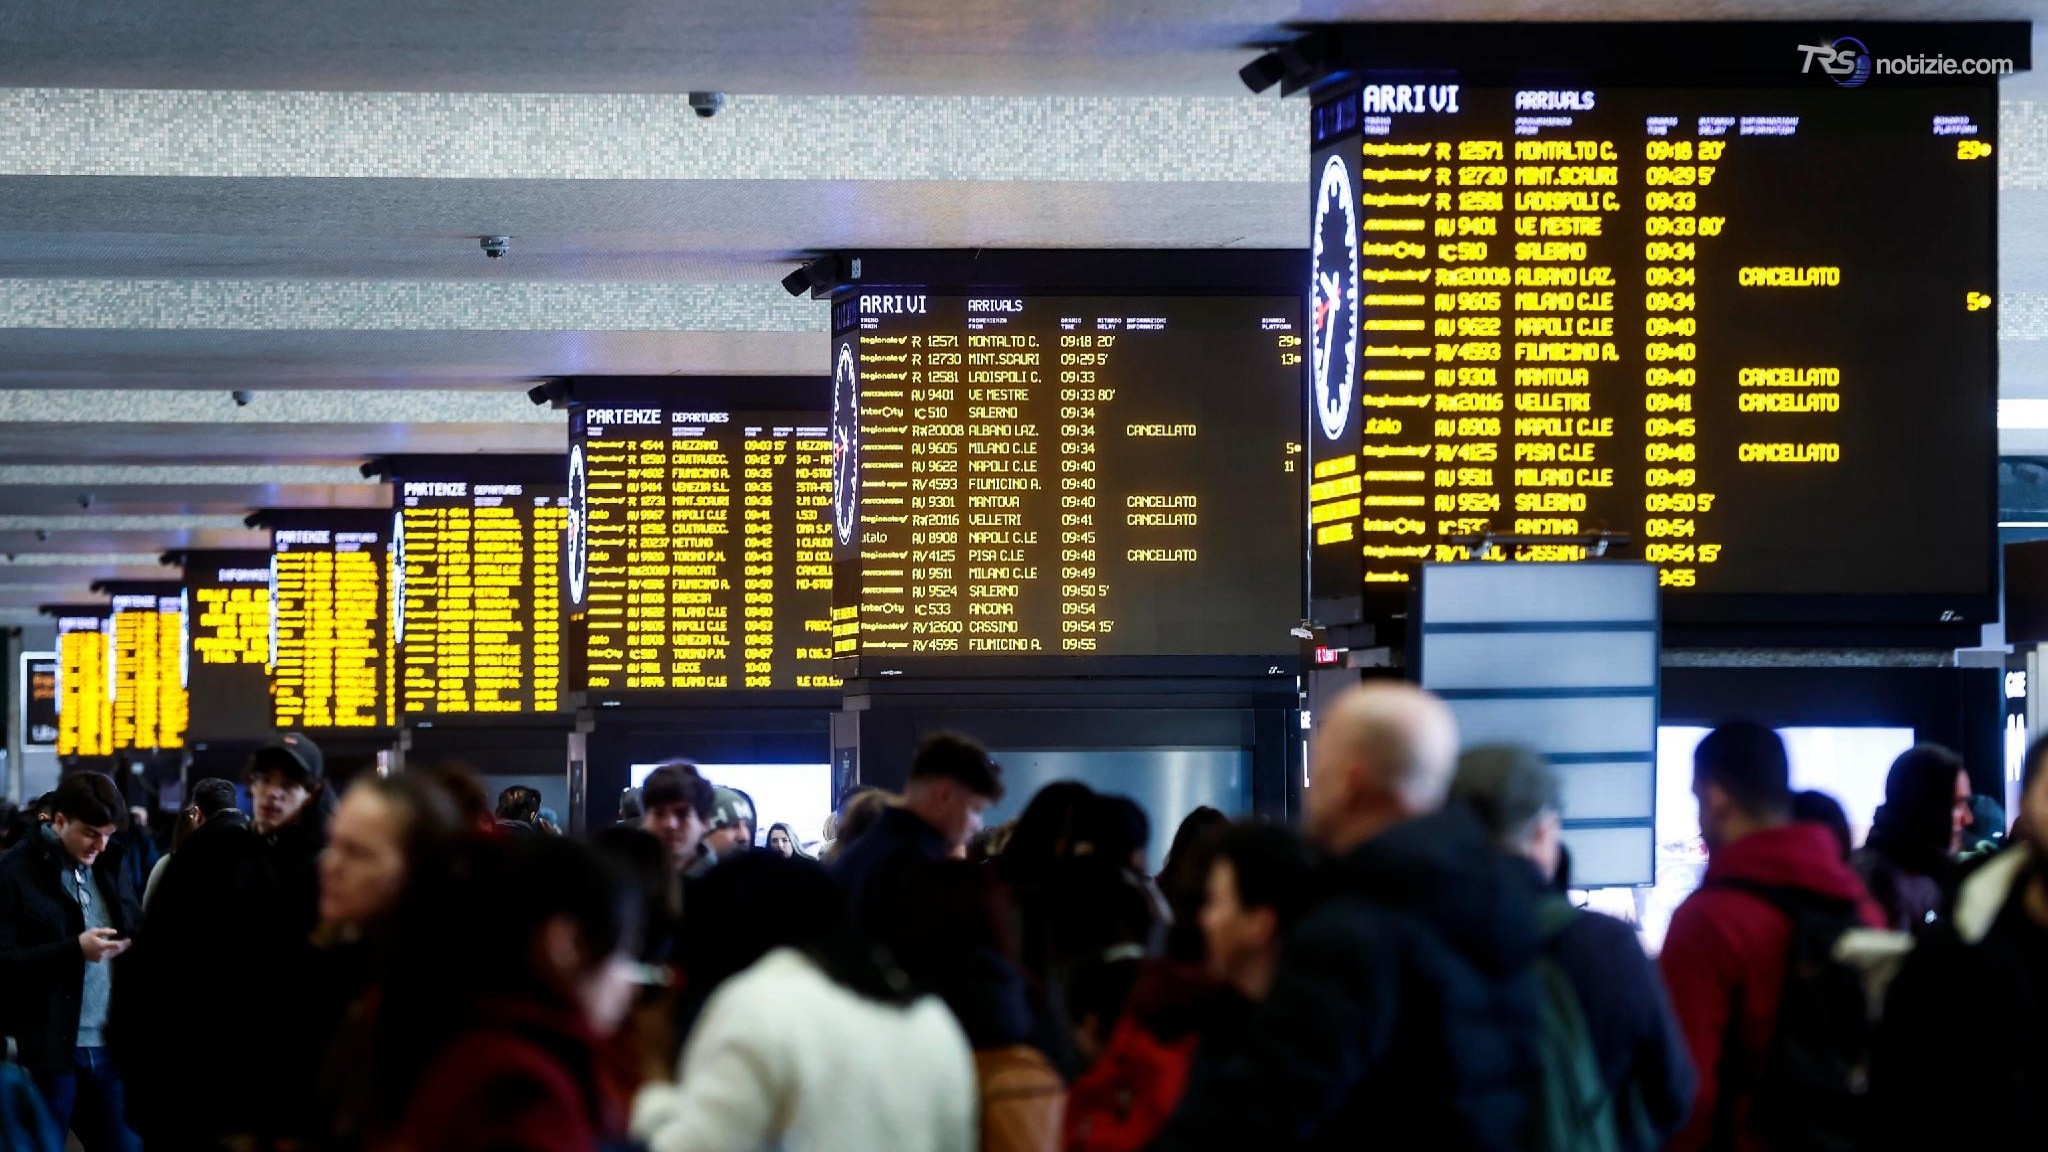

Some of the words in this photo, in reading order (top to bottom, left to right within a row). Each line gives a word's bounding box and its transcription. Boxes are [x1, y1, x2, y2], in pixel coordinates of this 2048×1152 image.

[1363, 85, 1459, 113] ARRIVI
[1515, 91, 1595, 110] ARRIVALS
[1515, 141, 1597, 159] MONTALTO
[1957, 141, 1979, 159] 29
[1646, 166, 1696, 184] 09:29
[1515, 191, 1599, 209] LADISPOLI
[1515, 217, 1537, 235] VE
[1540, 217, 1602, 235] MESTRE
[1515, 242, 1586, 260] SALERNO
[1515, 267, 1577, 285] ALBANO
[1739, 267, 1840, 285] CANCELLATO
[860, 296, 926, 313] ARRIVI
[969, 300, 1022, 311] ARRIVALS
[1515, 292, 1574, 310] MILANO
[1966, 292, 1980, 310] 5
[1515, 317, 1573, 335] NAPOLI
[912, 336, 922, 348] R
[928, 336, 959, 348] 12571
[968, 336, 1025, 348] MONTALTO
[1028, 336, 1040, 348] C.
[1061, 336, 1092, 348] 09:18
[1279, 336, 1293, 348] 29
[912, 354, 922, 366] R
[928, 353, 962, 365] 12730
[968, 353, 1040, 365] MINT.SCAURI
[1061, 353, 1094, 365] 09:29
[1282, 353, 1294, 365] 13
[912, 372, 922, 384] R
[928, 371, 959, 383] 12581
[968, 371, 1026, 383] LADISPOLI
[1030, 371, 1042, 383] C.
[1061, 371, 1095, 383] 09:33
[1515, 368, 1589, 386] MANTOVA
[1739, 368, 1839, 386] CANCELLATO
[912, 390, 925, 402] AV
[928, 389, 954, 401] 9401
[968, 389, 983, 401] VE
[987, 389, 1029, 401] MESTRE
[1061, 389, 1095, 401] 09:33
[1515, 393, 1591, 411] VELLETRI
[587, 409, 662, 424] PARTENZE
[672, 413, 730, 423] DEPARTURES
[915, 408, 926, 420] IC
[928, 407, 948, 419] 510
[968, 407, 1018, 419] SALERNO
[1061, 407, 1096, 419] 09:34
[968, 425, 1012, 437] ALBANO
[1015, 425, 1039, 437] LAZ.
[1062, 425, 1096, 437] 09:34
[1127, 425, 1196, 437] CANCELLATO
[912, 443, 925, 455] AV
[928, 442, 958, 454] 9605
[968, 442, 1010, 454] MILANO
[1013, 442, 1038, 454] C.LE
[1062, 442, 1096, 454] 09:34
[1515, 443, 1555, 461] PISA
[912, 461, 925, 473] AV
[928, 460, 958, 472] 9622
[968, 460, 1008, 472] NAPOLI
[1013, 460, 1038, 472] C.LE
[1062, 460, 1096, 472] 09:40
[1284, 460, 1294, 472] 11
[404, 482, 467, 496] PARTENZE
[913, 479, 928, 491] RV
[930, 478, 958, 490] 4593
[968, 478, 1028, 490] FIUMICINO
[1030, 478, 1042, 490] A.
[1062, 478, 1096, 490] 09:40
[912, 497, 925, 509] AV
[928, 496, 956, 508] 9301
[968, 496, 1020, 508] MANTOVA
[1062, 496, 1096, 508] 09:40
[1128, 496, 1196, 508] CANCELLATO
[969, 514, 1022, 526] VELLETRI
[1062, 514, 1093, 526] 09:41
[1128, 514, 1196, 526] CANCELLATO
[912, 533, 925, 545] AV
[928, 532, 958, 544] 8908
[968, 532, 1009, 544] NAPOLI
[1013, 532, 1038, 544] C.LE
[1062, 532, 1096, 544] 09:45
[913, 550, 928, 562] RV
[928, 549, 956, 561] 4125
[969, 549, 996, 561] PISA
[1000, 549, 1024, 561] C.LE
[1062, 549, 1096, 561] 09:48
[1128, 549, 1196, 561] CANCELLATO
[912, 568, 925, 580] AV
[928, 567, 952, 579] 9511
[969, 567, 1010, 579] MILANO
[1013, 567, 1038, 579] C.LE
[1062, 567, 1096, 579] 09:49
[912, 586, 925, 598] AV
[928, 585, 958, 597] 9524
[969, 585, 1018, 597] SALERNO
[1062, 585, 1096, 597] 09:50
[915, 604, 926, 616] IC
[928, 603, 951, 615] 533
[969, 603, 1014, 615] ANCONA
[1062, 603, 1096, 615] 09:54
[913, 622, 928, 634] RV
[929, 621, 962, 633] 12600
[969, 621, 1018, 633] CASSINO
[1062, 621, 1096, 633] 09:54
[913, 639, 928, 651] RV
[929, 638, 958, 650] 4595
[969, 638, 1028, 650] FIUMICINO
[1030, 638, 1042, 650] A.
[1062, 638, 1096, 650] 09:55
